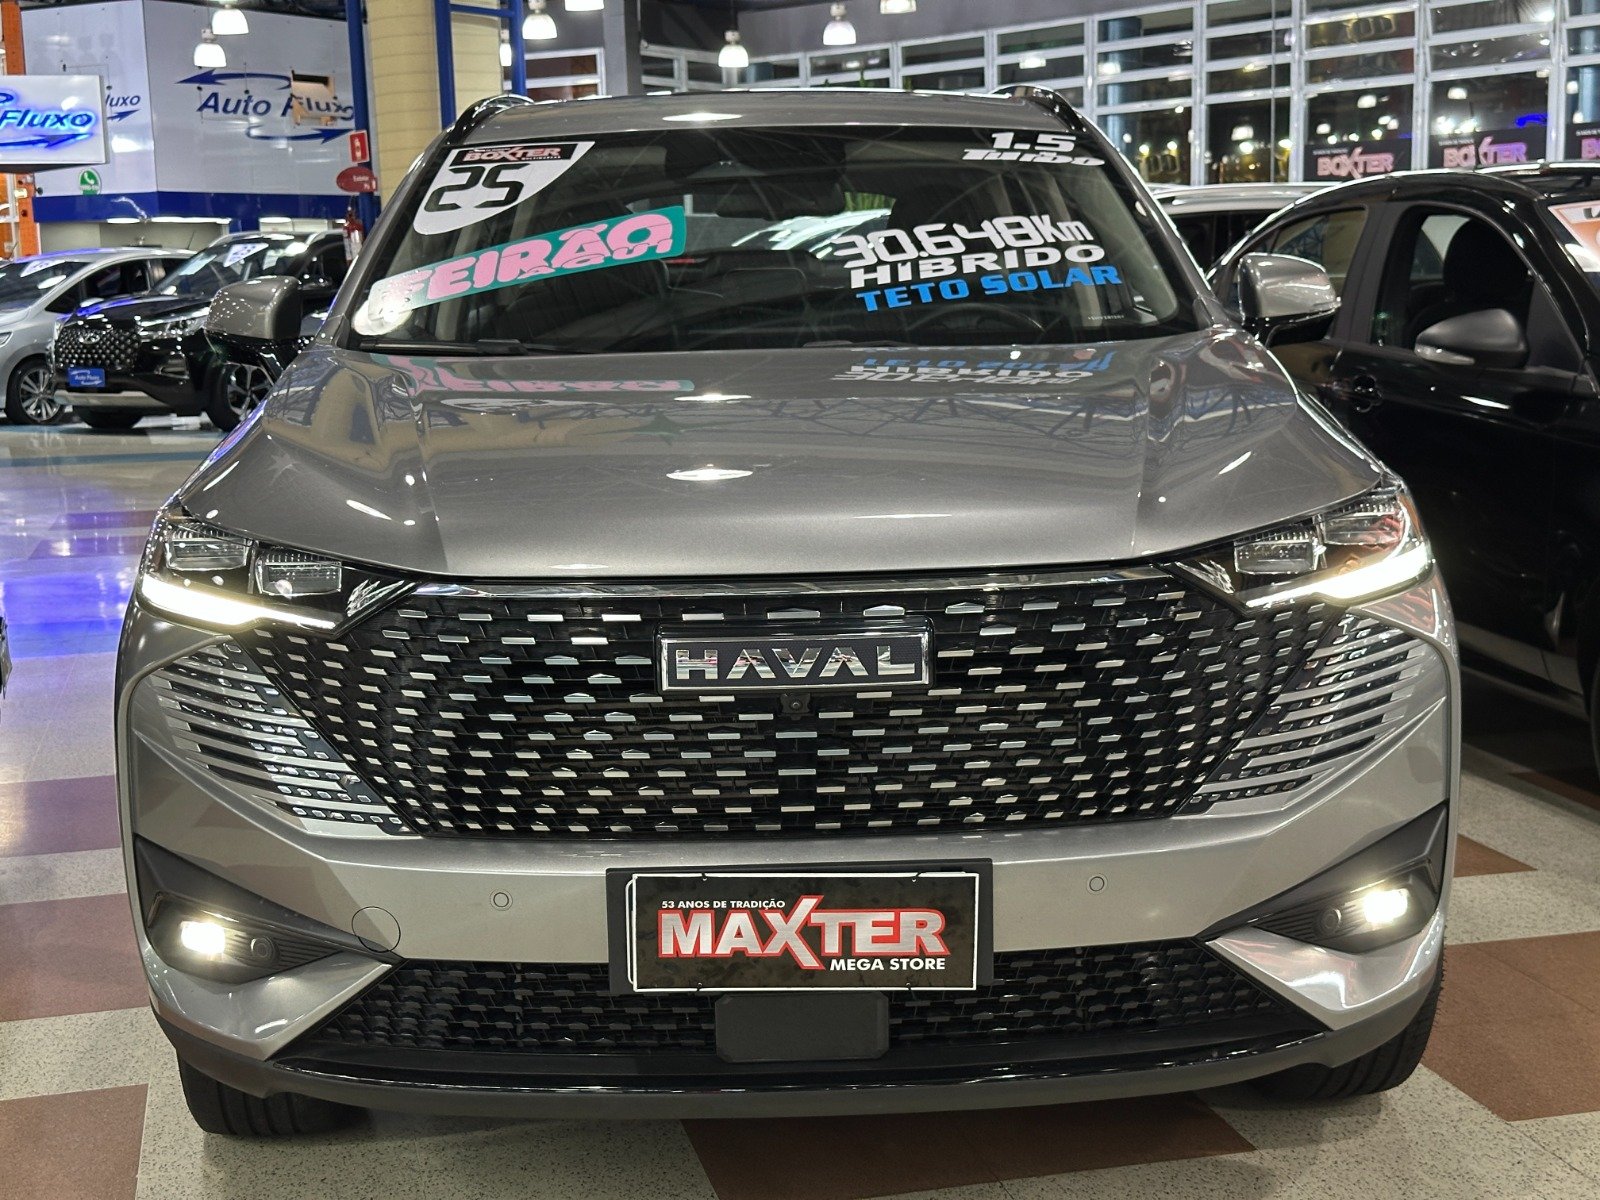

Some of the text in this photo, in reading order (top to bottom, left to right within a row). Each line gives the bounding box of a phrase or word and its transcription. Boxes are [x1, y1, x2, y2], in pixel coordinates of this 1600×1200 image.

[105, 94, 141, 108] luxo
[196, 91, 271, 116] Auto
[0, 109, 94, 128] Fluxo
[991, 131, 1076, 152] 1.5
[462, 146, 561, 162] BOXTER
[1317, 146, 1394, 179] BOXTER
[424, 162, 530, 213] 25
[856, 265, 1122, 312] TETO SOLAR
[676, 645, 916, 680] HAVAL
[661, 898, 786, 910] 53 ANOS DE TRADIÇÃO
[658, 894, 951, 970] MAXTER
[830, 957, 946, 971] MEGA STORE
